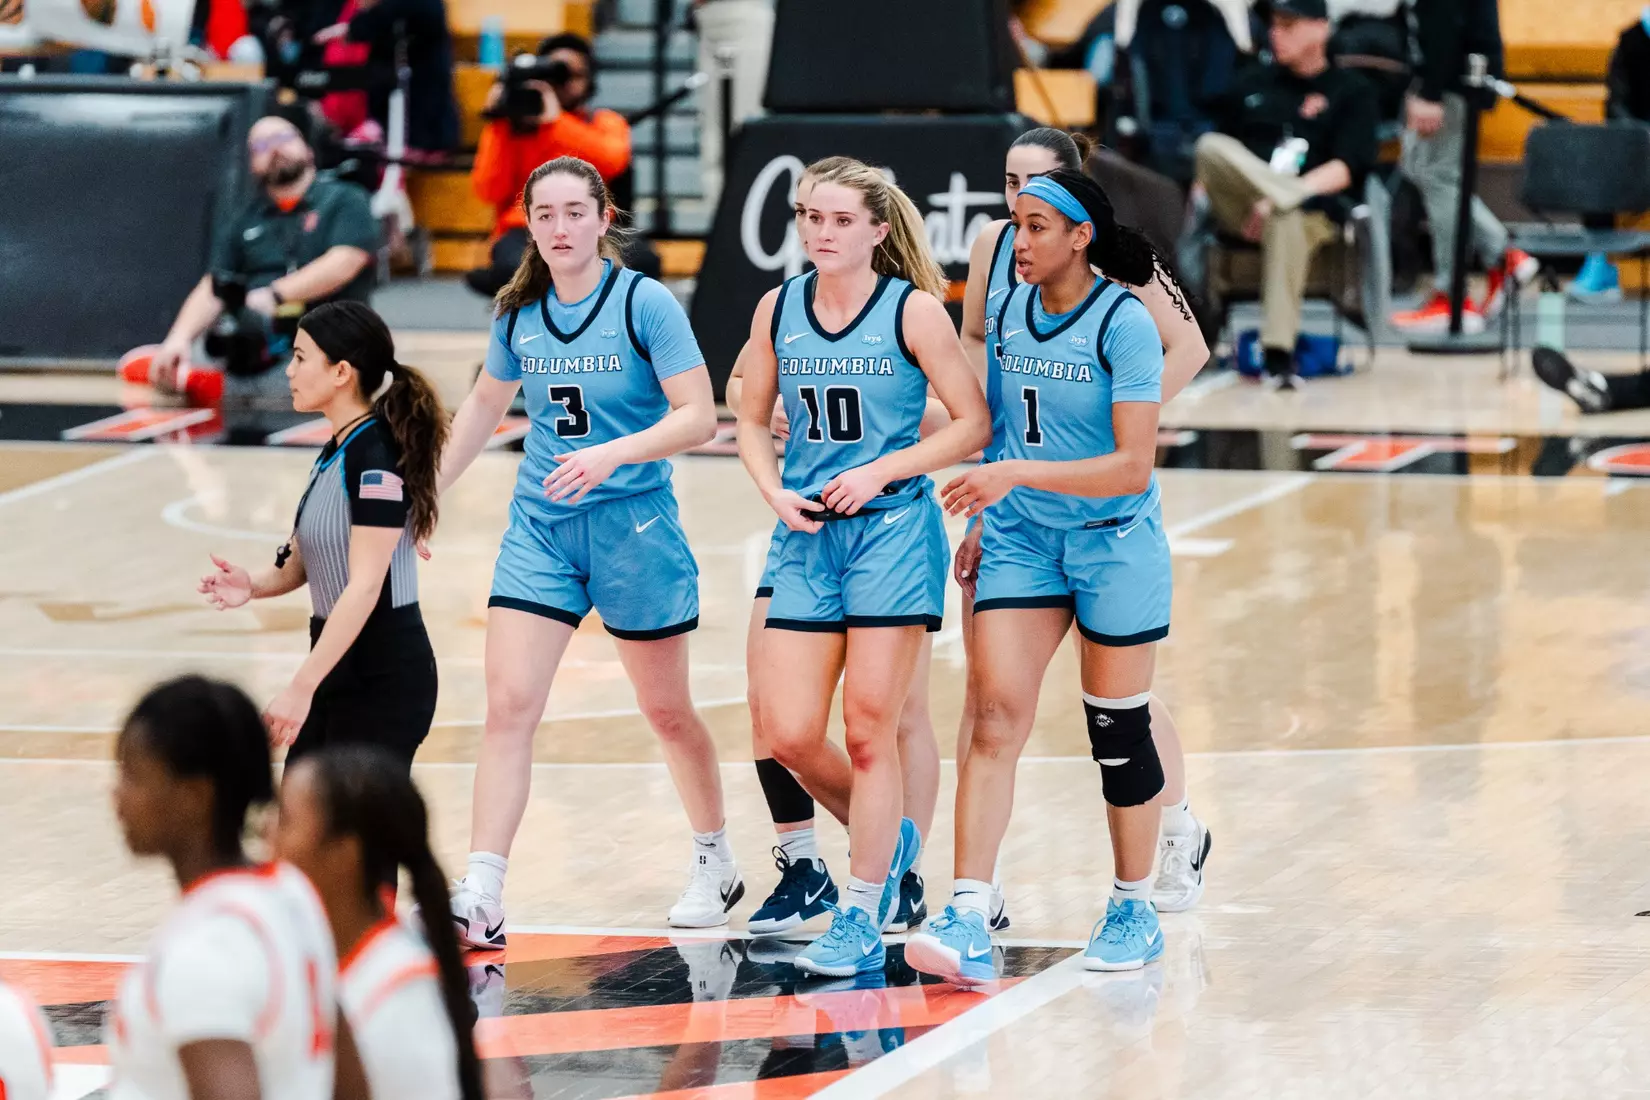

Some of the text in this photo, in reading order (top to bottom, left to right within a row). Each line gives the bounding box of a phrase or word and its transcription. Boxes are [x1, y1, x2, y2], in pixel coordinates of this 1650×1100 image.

[520, 353, 622, 374] COLUMBIA
[781, 356, 894, 376] COLUMBIA
[1001, 353, 1093, 382] COLUMBIA
[547, 383, 591, 439] 3
[798, 384, 864, 443] 10
[1021, 385, 1044, 447] 1
